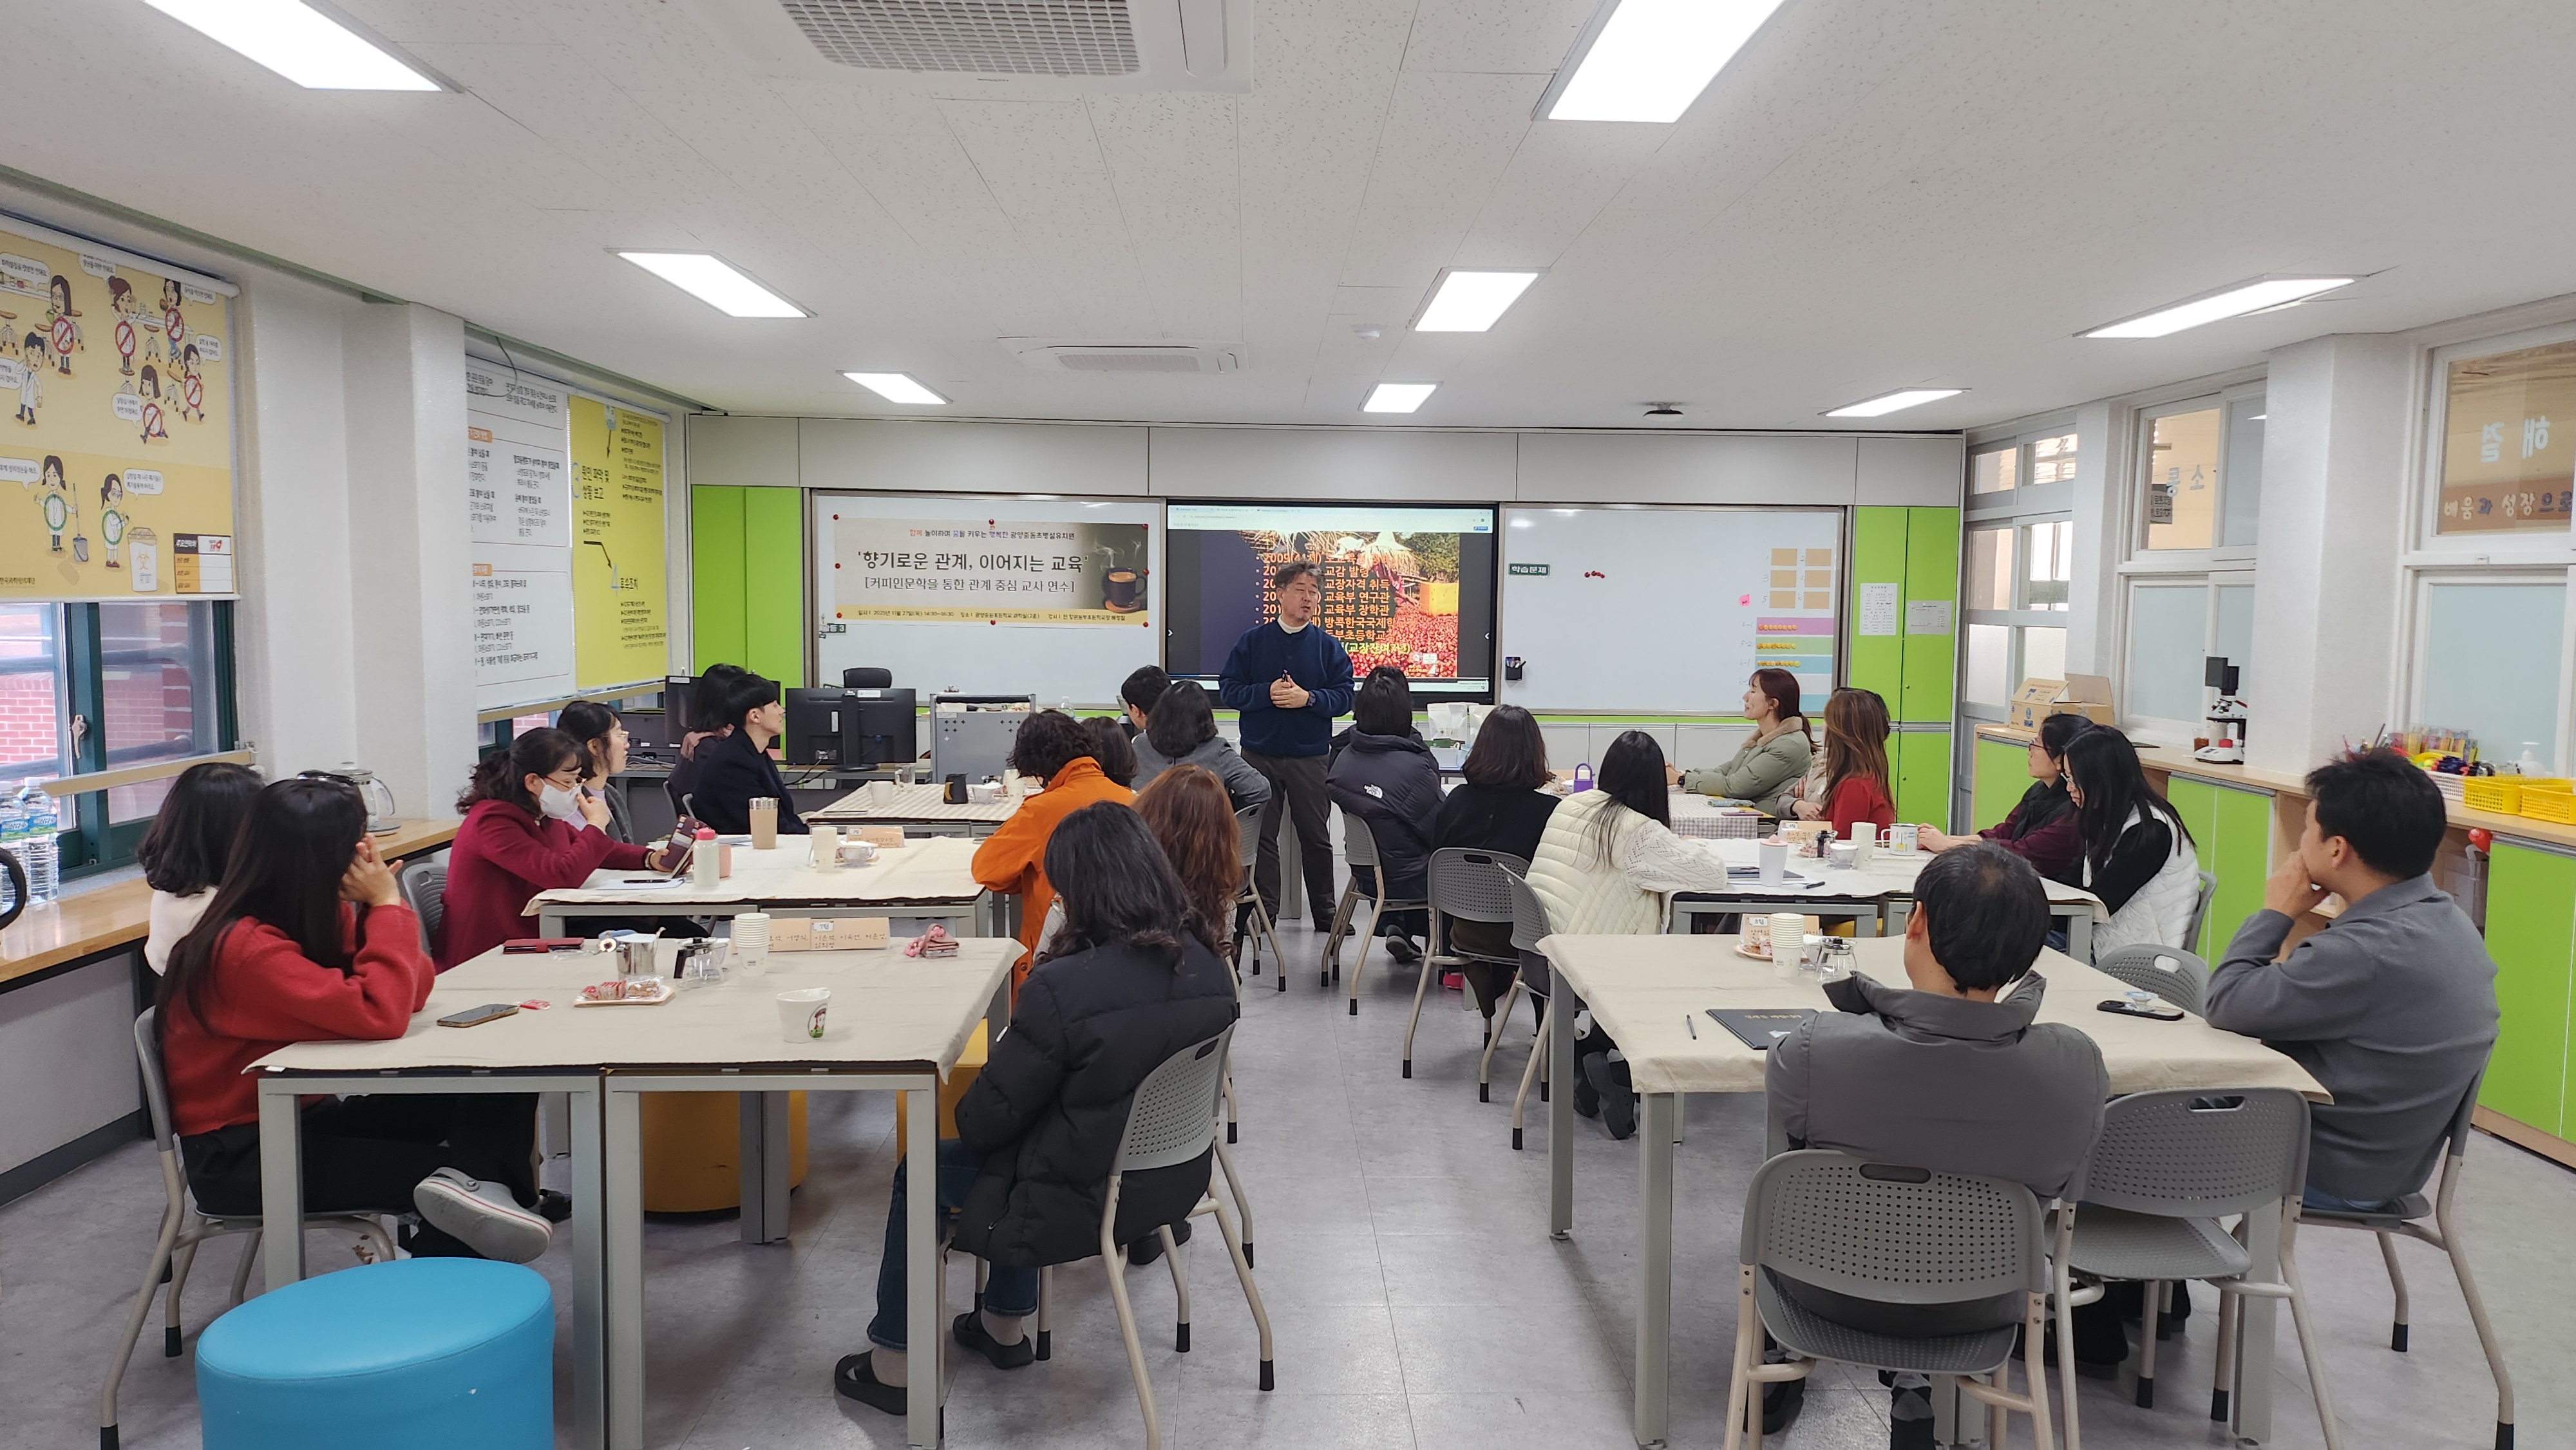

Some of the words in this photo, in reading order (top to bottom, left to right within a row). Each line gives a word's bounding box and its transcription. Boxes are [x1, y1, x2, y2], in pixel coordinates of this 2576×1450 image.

[2444, 496, 2493, 520] 배움과
[2502, 490, 2572, 517] 성장으로
[935, 553, 972, 570] 관계,
[980, 554, 1044, 572] 이어지는
[1051, 555, 1088, 573] 교육'
[1325, 567, 1346, 577] 교감
[1349, 567, 1369, 578] 발령
[620, 578, 638, 590] 후속조치
[865, 577, 938, 590] [커피인문학을
[942, 578, 964, 590] 통한
[969, 579, 991, 591] 관계
[995, 580, 1017, 592] 중심
[1021, 581, 1043, 592] 교사
[1048, 581, 1074, 592] 연수]
[1325, 579, 1366, 590] 교장자격
[1369, 579, 1390, 590] 취득
[1324, 592, 1356, 603] 교육부
[1359, 592, 1390, 603] 연구관
[1324, 604, 1356, 616] 교육부
[1358, 604, 1390, 616] 장학관
